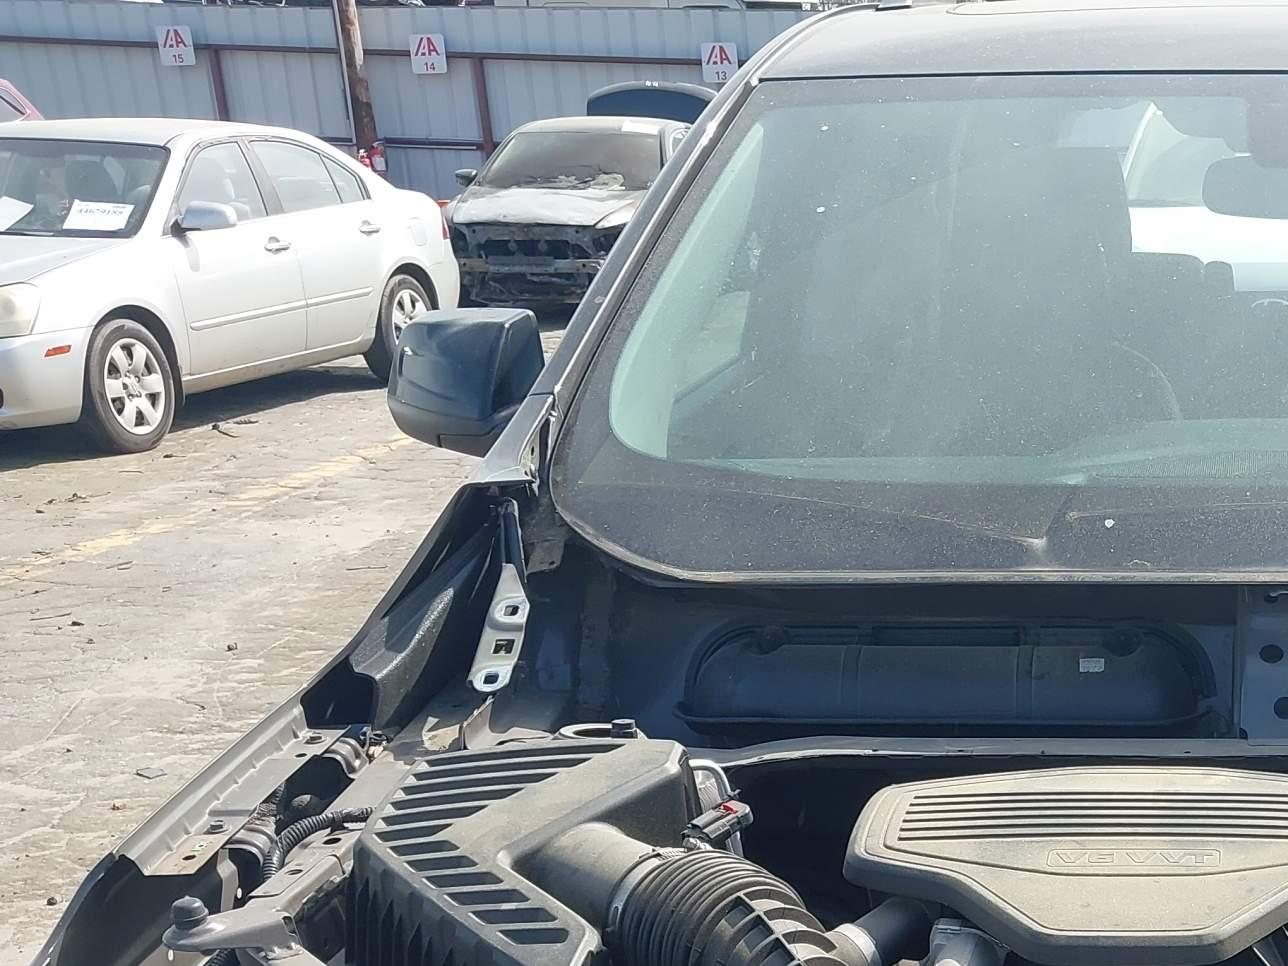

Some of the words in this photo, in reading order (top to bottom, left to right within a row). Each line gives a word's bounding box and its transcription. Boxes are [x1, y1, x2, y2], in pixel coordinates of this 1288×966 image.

[172, 54, 184, 64] 15
[423, 61, 435, 71] 14
[714, 70, 727, 80] 13
[1055, 851, 1115, 864] V6
[1125, 851, 1215, 864] VVT
